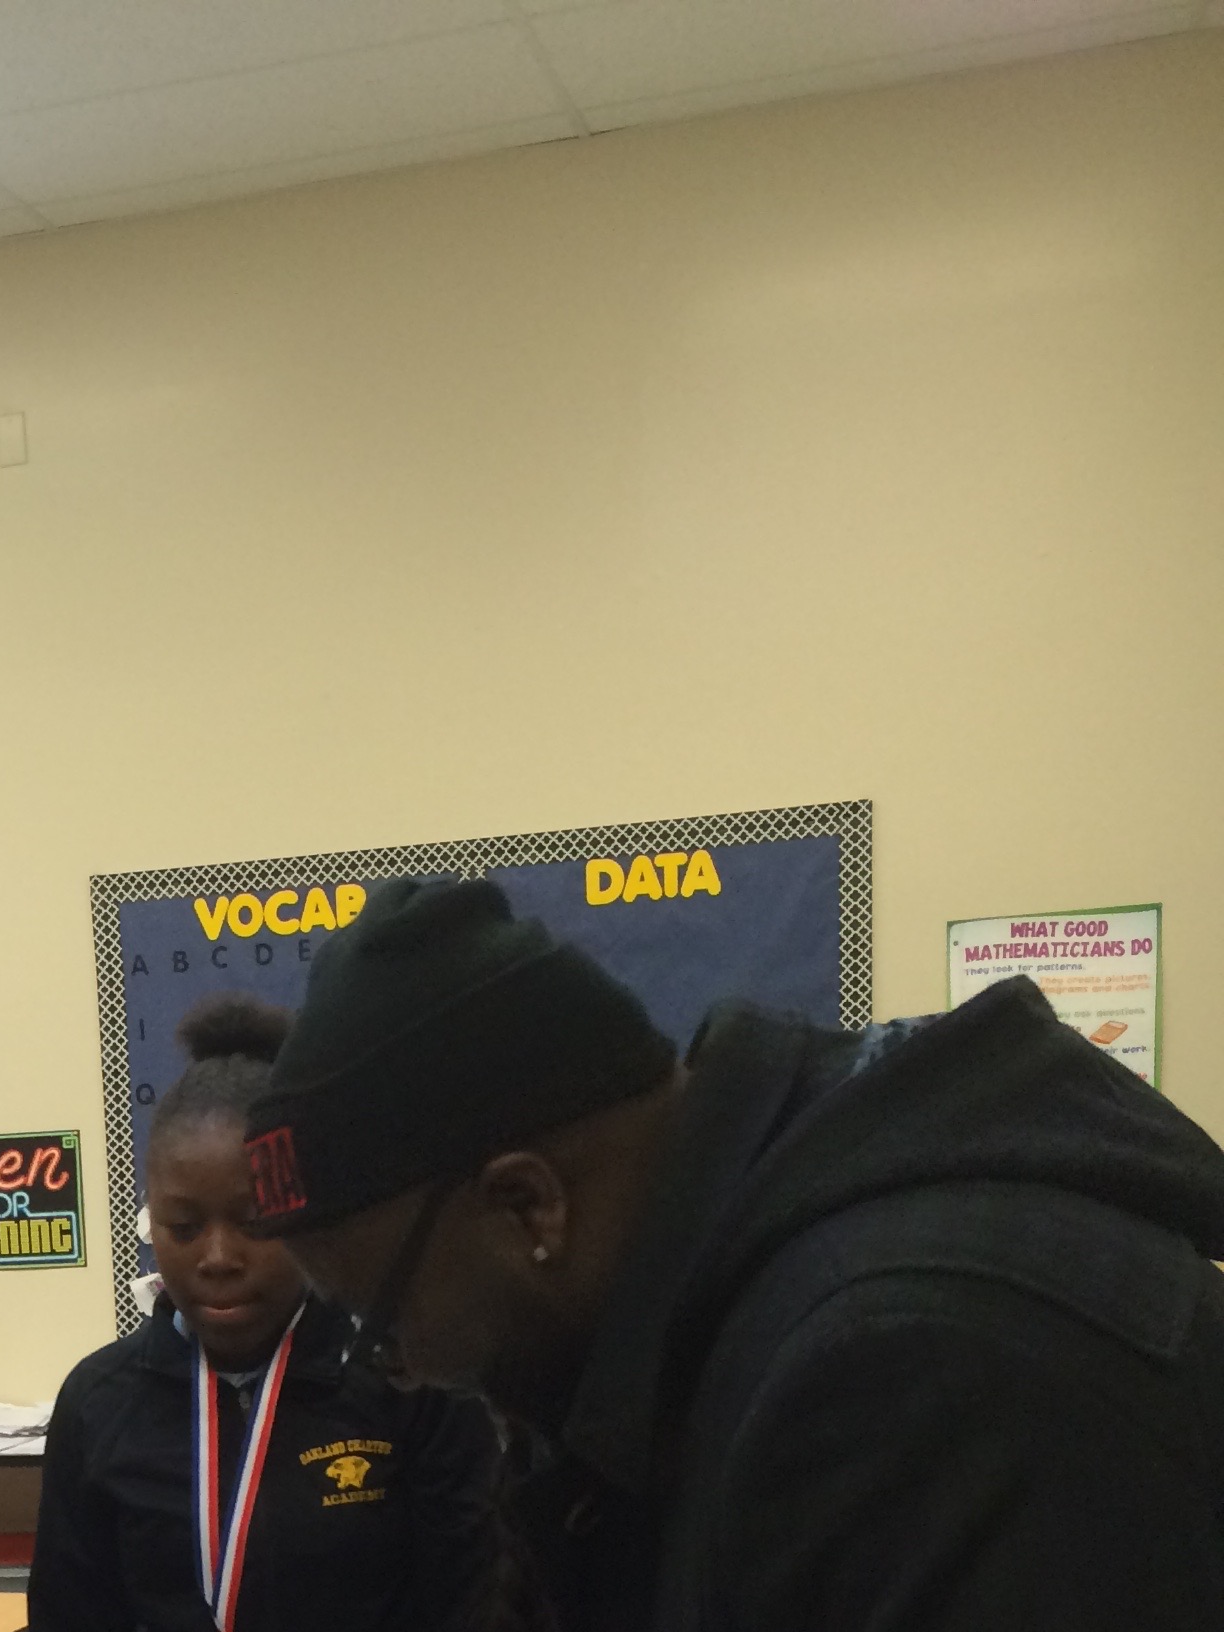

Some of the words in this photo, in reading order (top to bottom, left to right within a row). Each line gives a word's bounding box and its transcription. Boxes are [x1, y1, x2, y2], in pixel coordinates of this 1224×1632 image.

[586, 849, 722, 906] DATA
[194, 884, 367, 941] VOCAB
[1010, 921, 1059, 938] WHAT
[1064, 920, 1109, 937] GOOD
[131, 955, 149, 976] A
[172, 950, 190, 973] B
[211, 946, 228, 969] C
[255, 943, 274, 966] D
[298, 939, 312, 962] E
[965, 940, 1126, 962] MATHEMATICIANS
[1131, 938, 1153, 956] DO
[136, 1083, 156, 1105] Q
